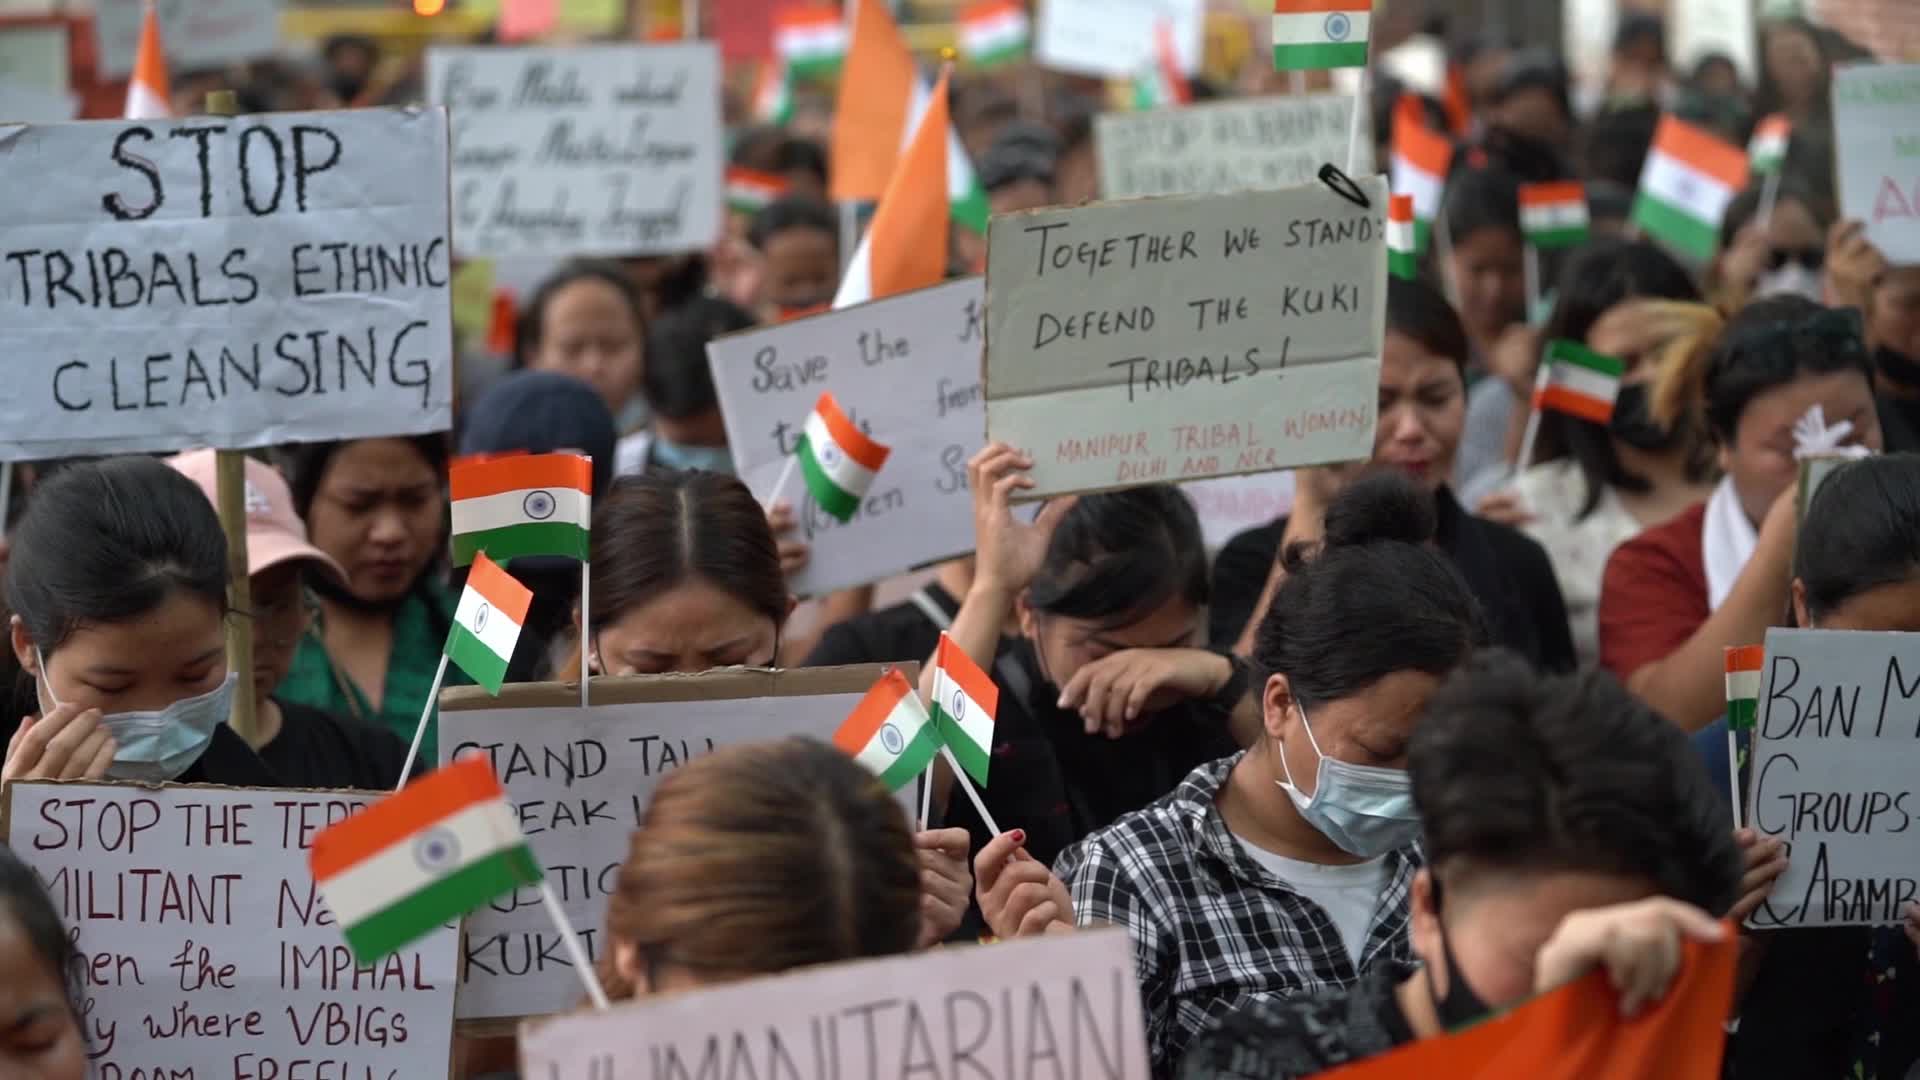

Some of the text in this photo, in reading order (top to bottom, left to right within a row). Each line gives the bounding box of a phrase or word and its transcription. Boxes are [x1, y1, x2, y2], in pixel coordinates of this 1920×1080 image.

[103, 125, 342, 221] STOP
[7, 237, 447, 308] TRIBALS ETHNIC
[1025, 222, 1198, 276] TOGETHER
[1224, 227, 1260, 260] WE
[1034, 284, 1359, 350] DEFEND THE KUKI
[53, 321, 431, 411] CLEANSING
[752, 328, 910, 392] Save the
[1056, 431, 1149, 463] MANIPUR
[1172, 421, 1262, 451] TRIBAL
[1117, 457, 1167, 481] DELHI
[1183, 456, 1218, 474] AND
[34, 798, 161, 853] STOP
[175, 804, 254, 848] THE
[170, 939, 236, 991] the
[281, 940, 435, 990] IMPHAL
